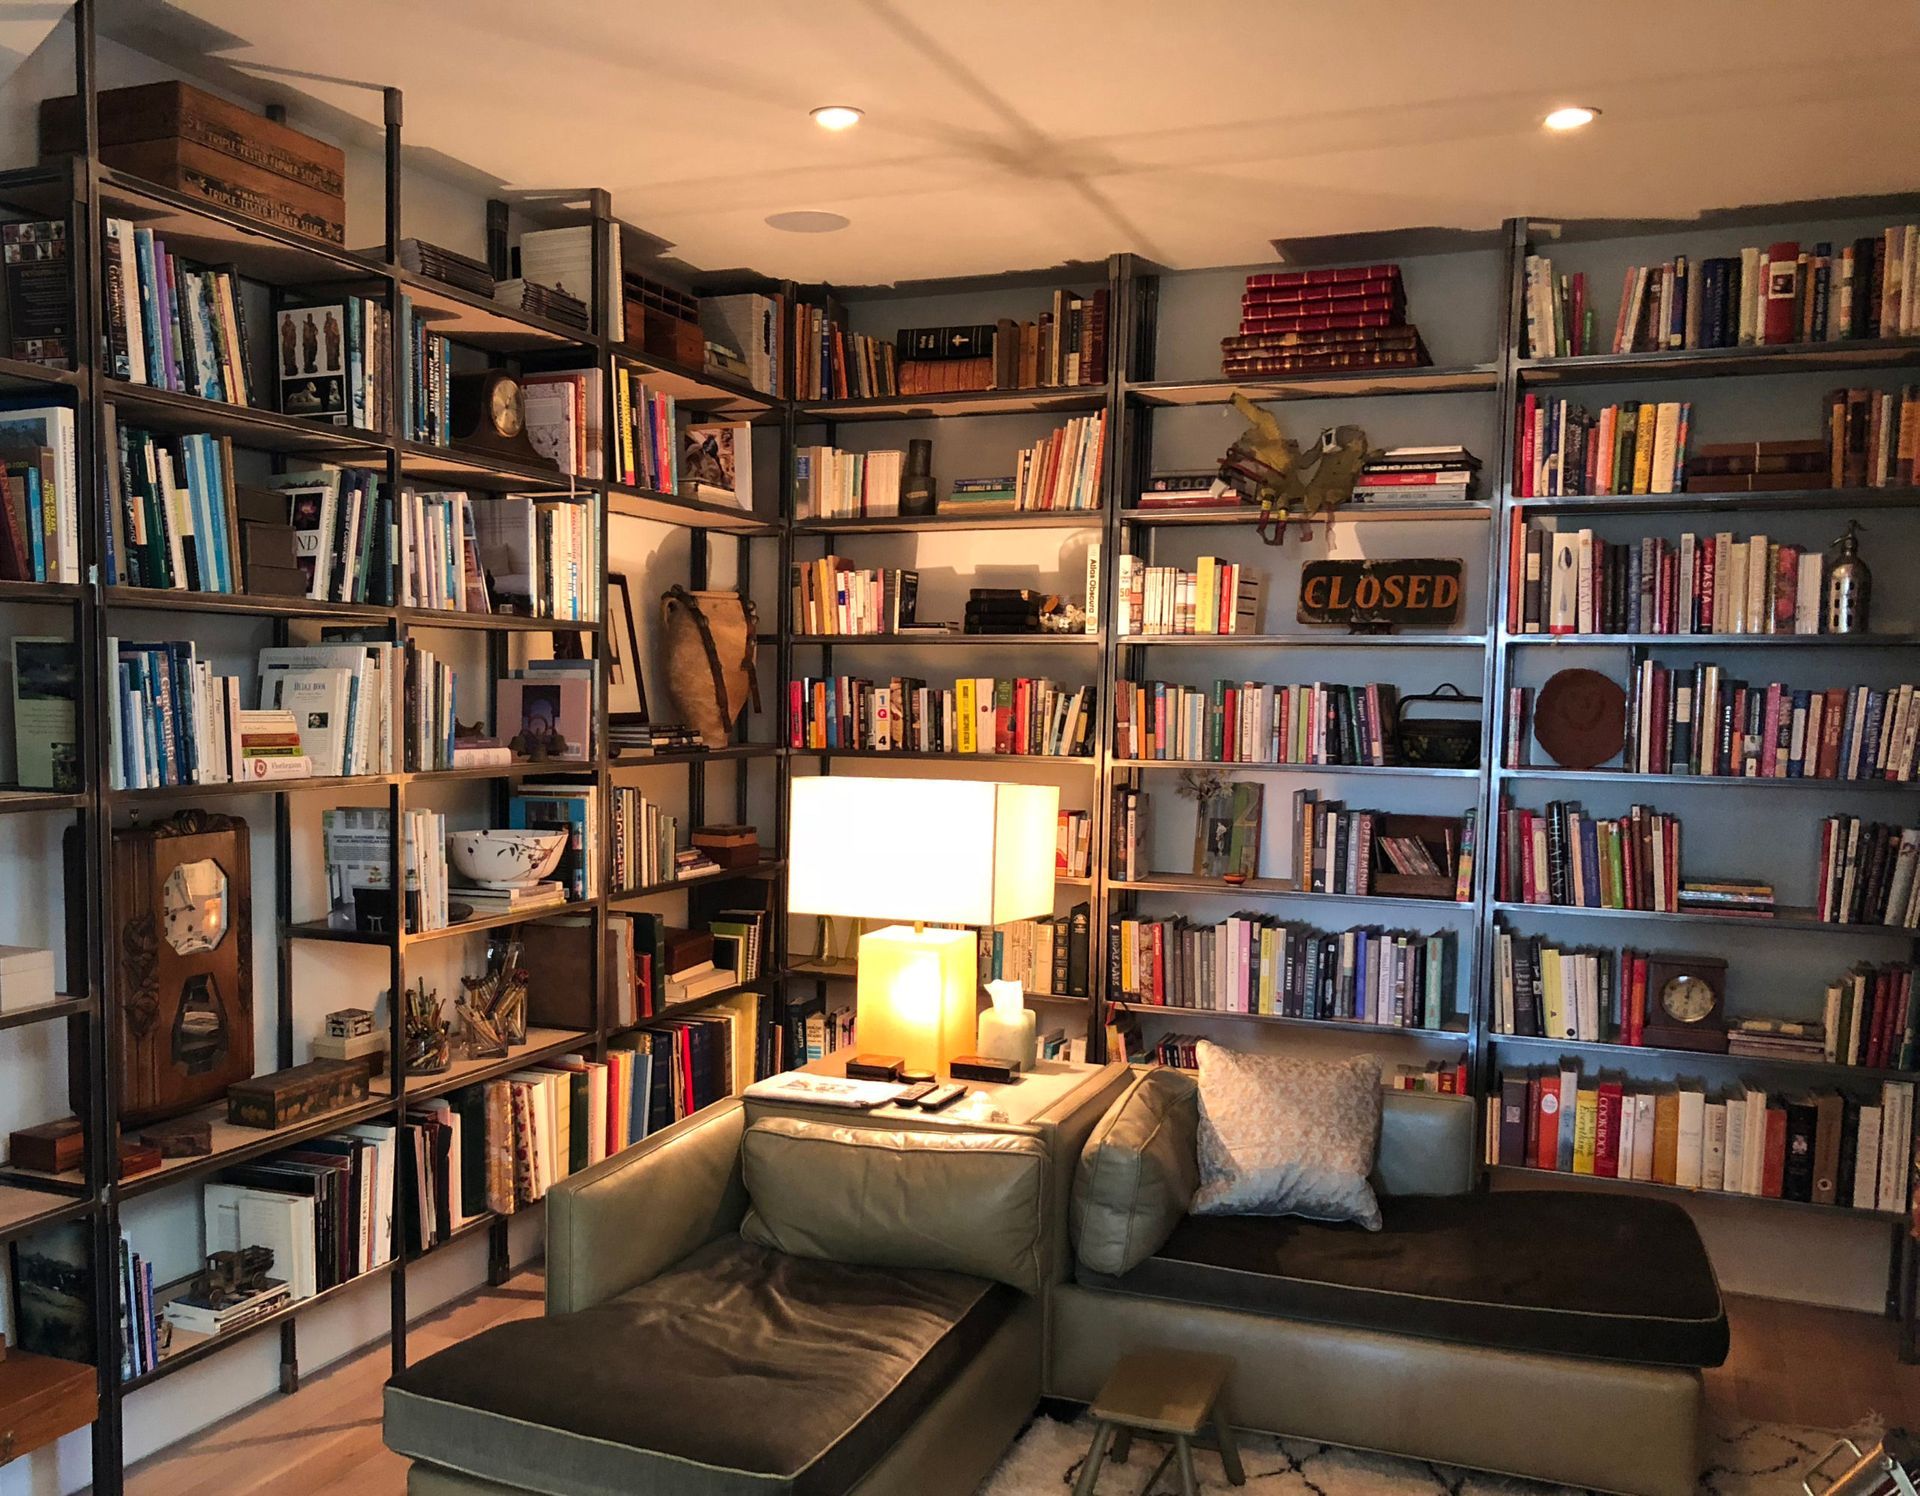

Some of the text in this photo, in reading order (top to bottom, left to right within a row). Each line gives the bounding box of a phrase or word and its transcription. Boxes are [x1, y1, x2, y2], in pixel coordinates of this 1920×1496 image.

[108, 264, 120, 328] GARDENING
[296, 536, 318, 550] ND
[1088, 580, 1097, 613] Obscura
[1304, 576, 1458, 609] CLOSED
[1581, 567, 1590, 615] EATALY
[1702, 564, 1713, 604] PASTA
[161, 677, 174, 760] Gardenista
[1360, 821, 1371, 887] OFF THE MENU
[1575, 1105, 1589, 1156] Everything
[1589, 1107, 1598, 1123] How
[1597, 1097, 1608, 1156] COOKBOOK
[1587, 1136, 1595, 1156] Cook
